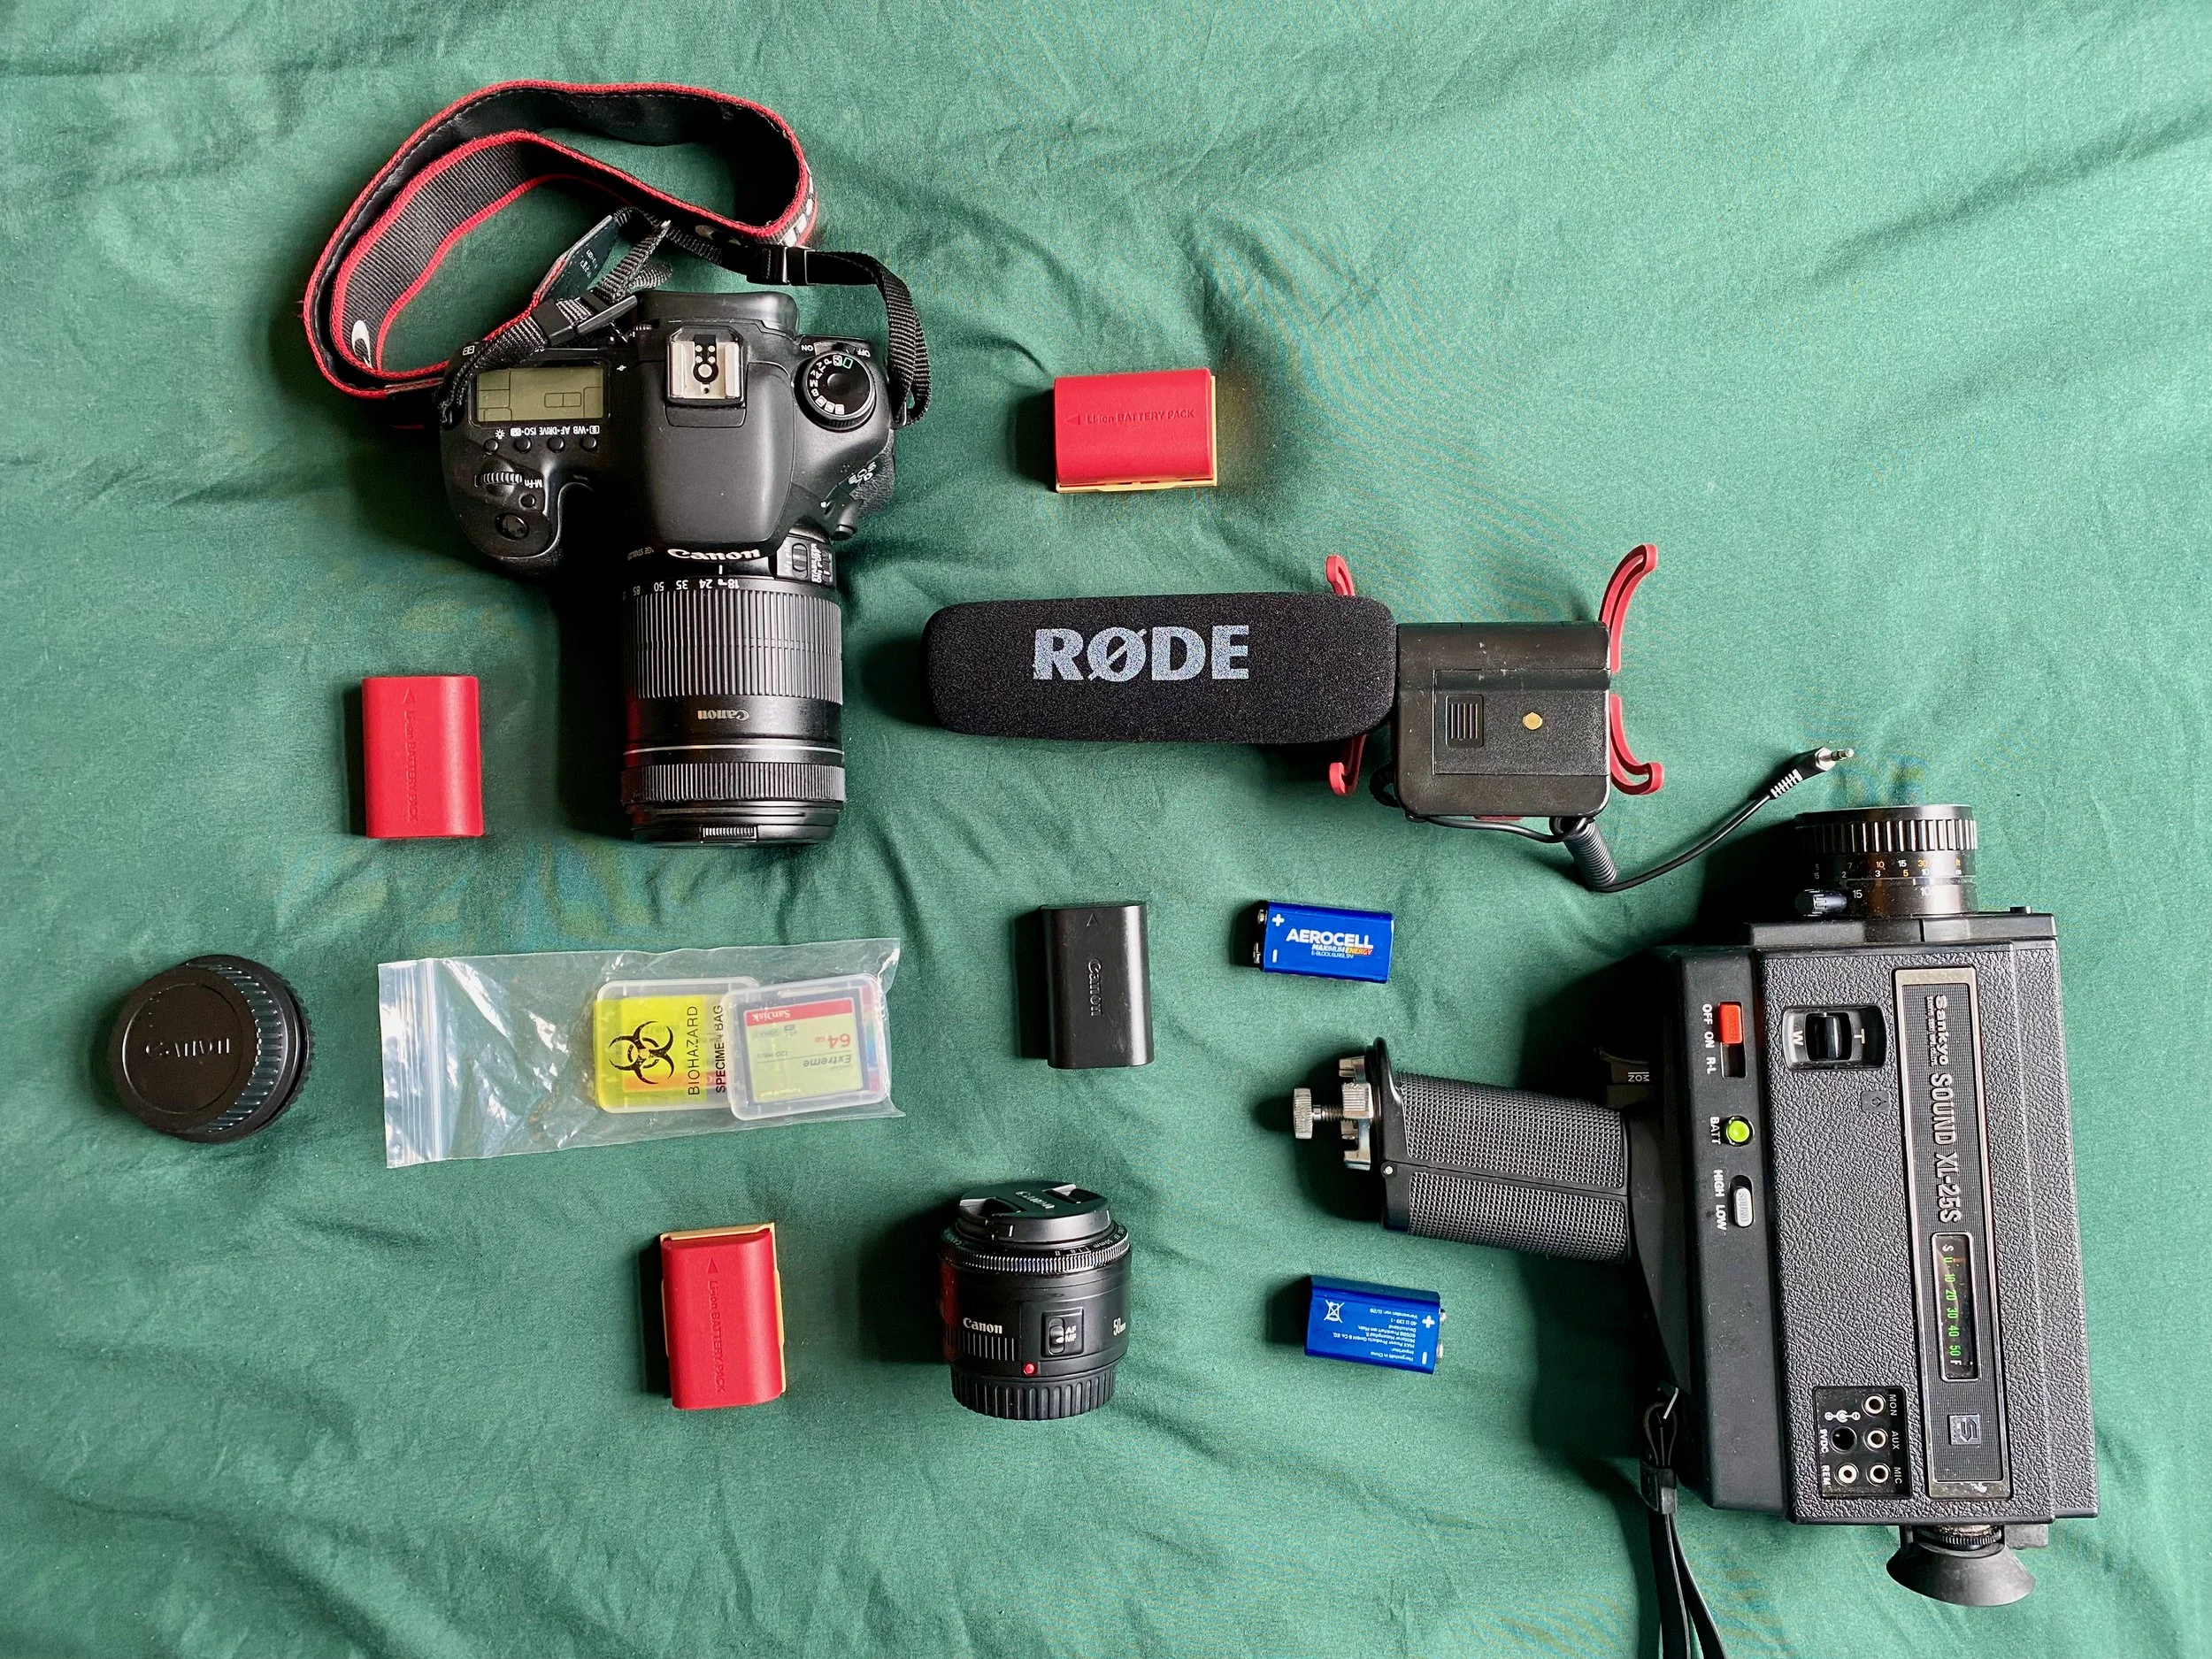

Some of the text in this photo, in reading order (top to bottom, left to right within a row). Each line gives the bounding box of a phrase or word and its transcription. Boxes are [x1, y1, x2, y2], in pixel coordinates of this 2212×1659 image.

[856, 348, 871, 357] OFF
[810, 370, 823, 379] Av
[817, 361, 826, 373] Tv
[809, 379, 818, 388] M
[1116, 411, 1165, 423] BATTERY
[1166, 409, 1194, 419] PACK
[524, 479, 543, 488] M-Fn
[667, 548, 761, 561] Canon
[633, 585, 641, 596] 85
[654, 580, 664, 592] 50
[676, 579, 688, 590] 35
[699, 579, 713, 589] 24
[727, 579, 740, 589] 18
[1033, 624, 1249, 682] RØDE
[697, 709, 750, 721] Canon
[405, 741, 418, 790] BATTERY
[407, 793, 419, 823] PACK
[1853, 887, 1931, 899] 15 10
[1286, 928, 1373, 949] AEROCELL
[1311, 943, 1373, 956] MAXIMUM ENERGY
[1087, 958, 1102, 1017] Canon
[752, 1009, 791, 1021] SanDisk
[1702, 1003, 1713, 1025] OFF
[827, 1033, 851, 1049] 64
[1704, 1032, 1715, 1048] ON
[1793, 1028, 1865, 1046] W T
[687, 1006, 701, 1095] BIOHAZARD
[713, 1004, 727, 1094] SPECIMEN BAG
[802, 1054, 853, 1068] Extreme
[1931, 995, 1962, 1223] Sankyo SOUND XL-25S
[1709, 1116, 1722, 1145] BATT
[1713, 1170, 1727, 1231] HIGH LOW
[1945, 1272, 1955, 1283] 10
[1945, 1289, 1957, 1301] 20
[1947, 1308, 1959, 1318] 30
[963, 1317, 1003, 1334] Canon
[1065, 1325, 1077, 1334] AF
[1948, 1325, 1959, 1337] 40
[708, 1280, 726, 1394] Li-ion BATTERY PACK
[1065, 1333, 1077, 1343] MF
[1949, 1345, 1961, 1356] 50
[1889, 1394, 1898, 1416] MON
[1820, 1428, 1830, 1453] 9VDC
[1892, 1430, 1901, 1450] AUX
[1821, 1465, 1831, 1486] REM
[1893, 1466, 1902, 1485] MIC
